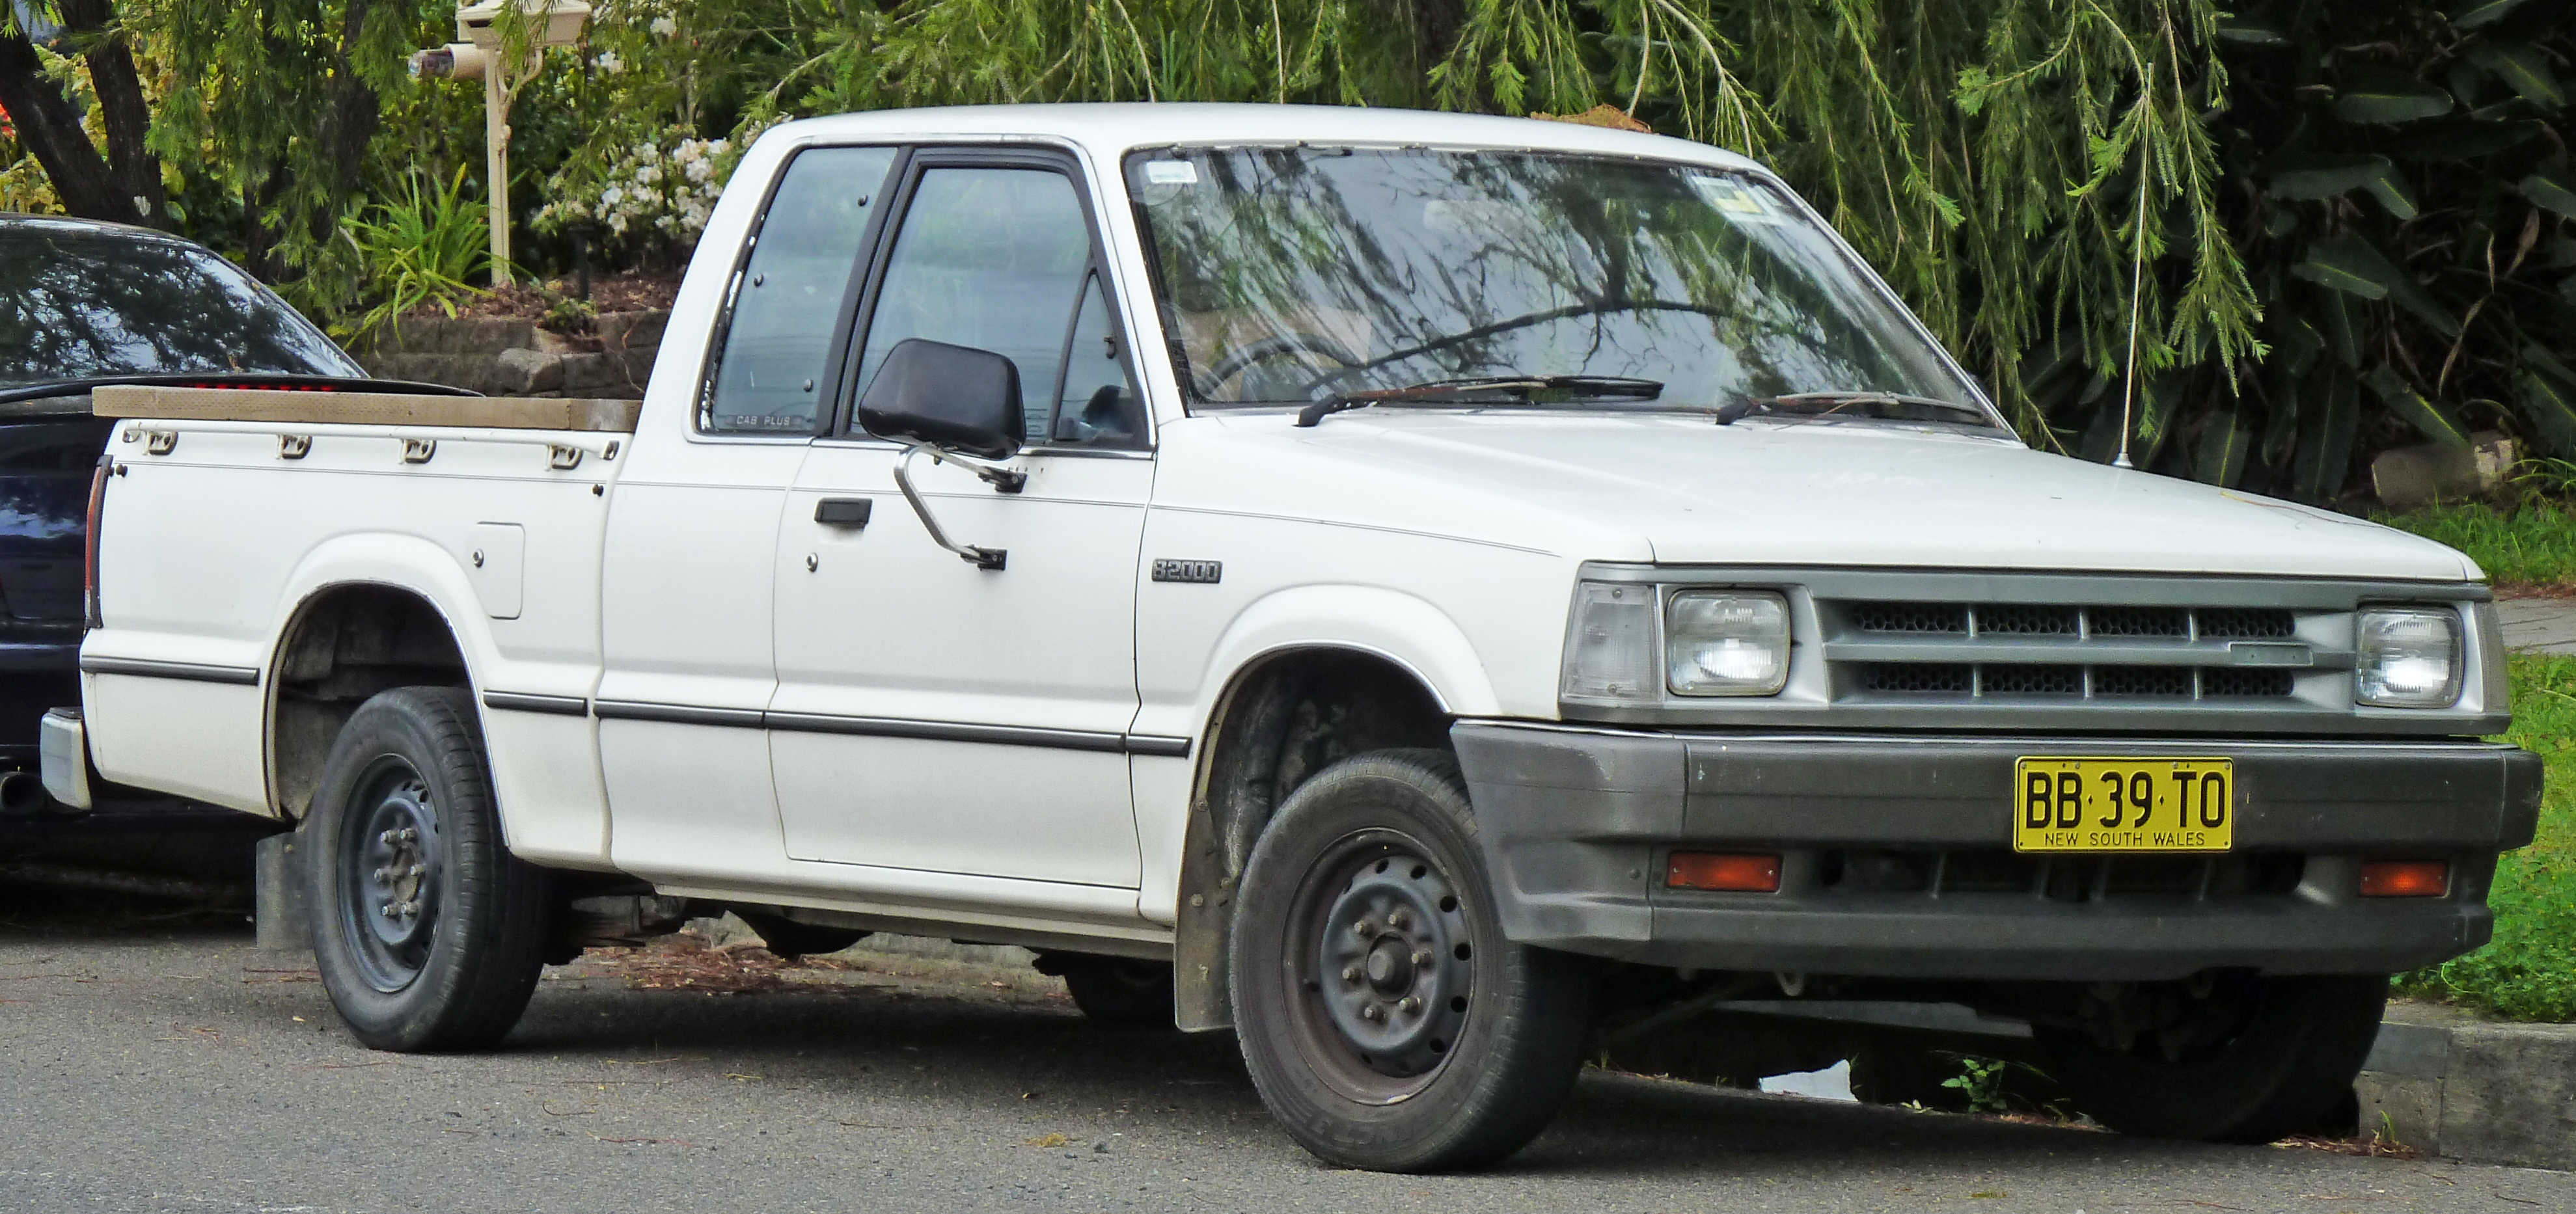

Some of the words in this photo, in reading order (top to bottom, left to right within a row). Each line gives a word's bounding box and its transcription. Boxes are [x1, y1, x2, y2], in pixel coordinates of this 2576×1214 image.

[737, 416, 758, 425] CAB
[764, 416, 791, 425] PLUS
[2045, 832, 2079, 846] NEW
[2090, 832, 2143, 846] SOUTH
[2154, 832, 2205, 846] WALES
